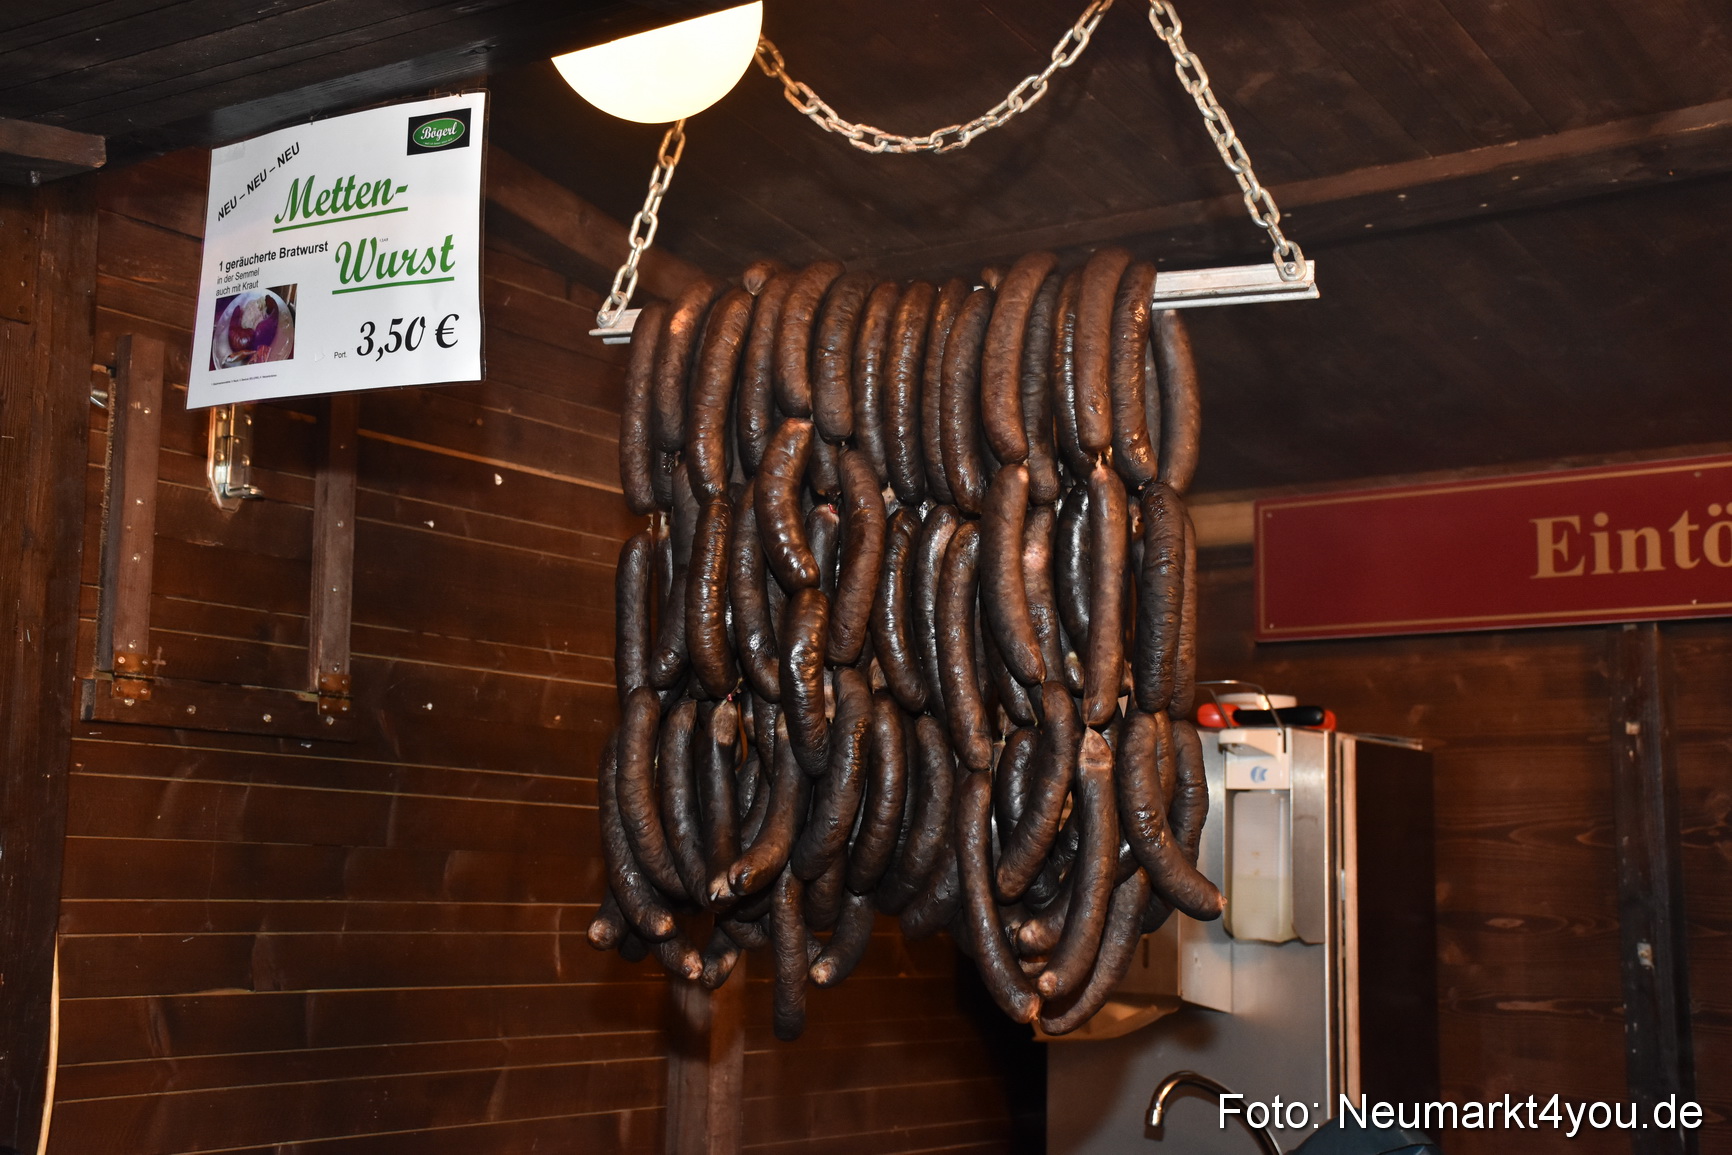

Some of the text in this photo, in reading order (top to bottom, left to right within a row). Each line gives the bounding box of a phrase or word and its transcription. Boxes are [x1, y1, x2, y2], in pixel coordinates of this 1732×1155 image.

[420, 121, 458, 141] Bögerl
[217, 195, 238, 221] NEU
[246, 168, 267, 195] NEU
[276, 141, 300, 168] NEU
[273, 174, 409, 225] Metten-
[216, 267, 260, 285] in der Semmel
[219, 240, 329, 273] 1 geräucherte Bratwurst
[334, 234, 456, 285] Wurst
[215, 280, 259, 296] auch mit Kraut
[356, 316, 426, 362] 3,50
[434, 313, 460, 349] €
